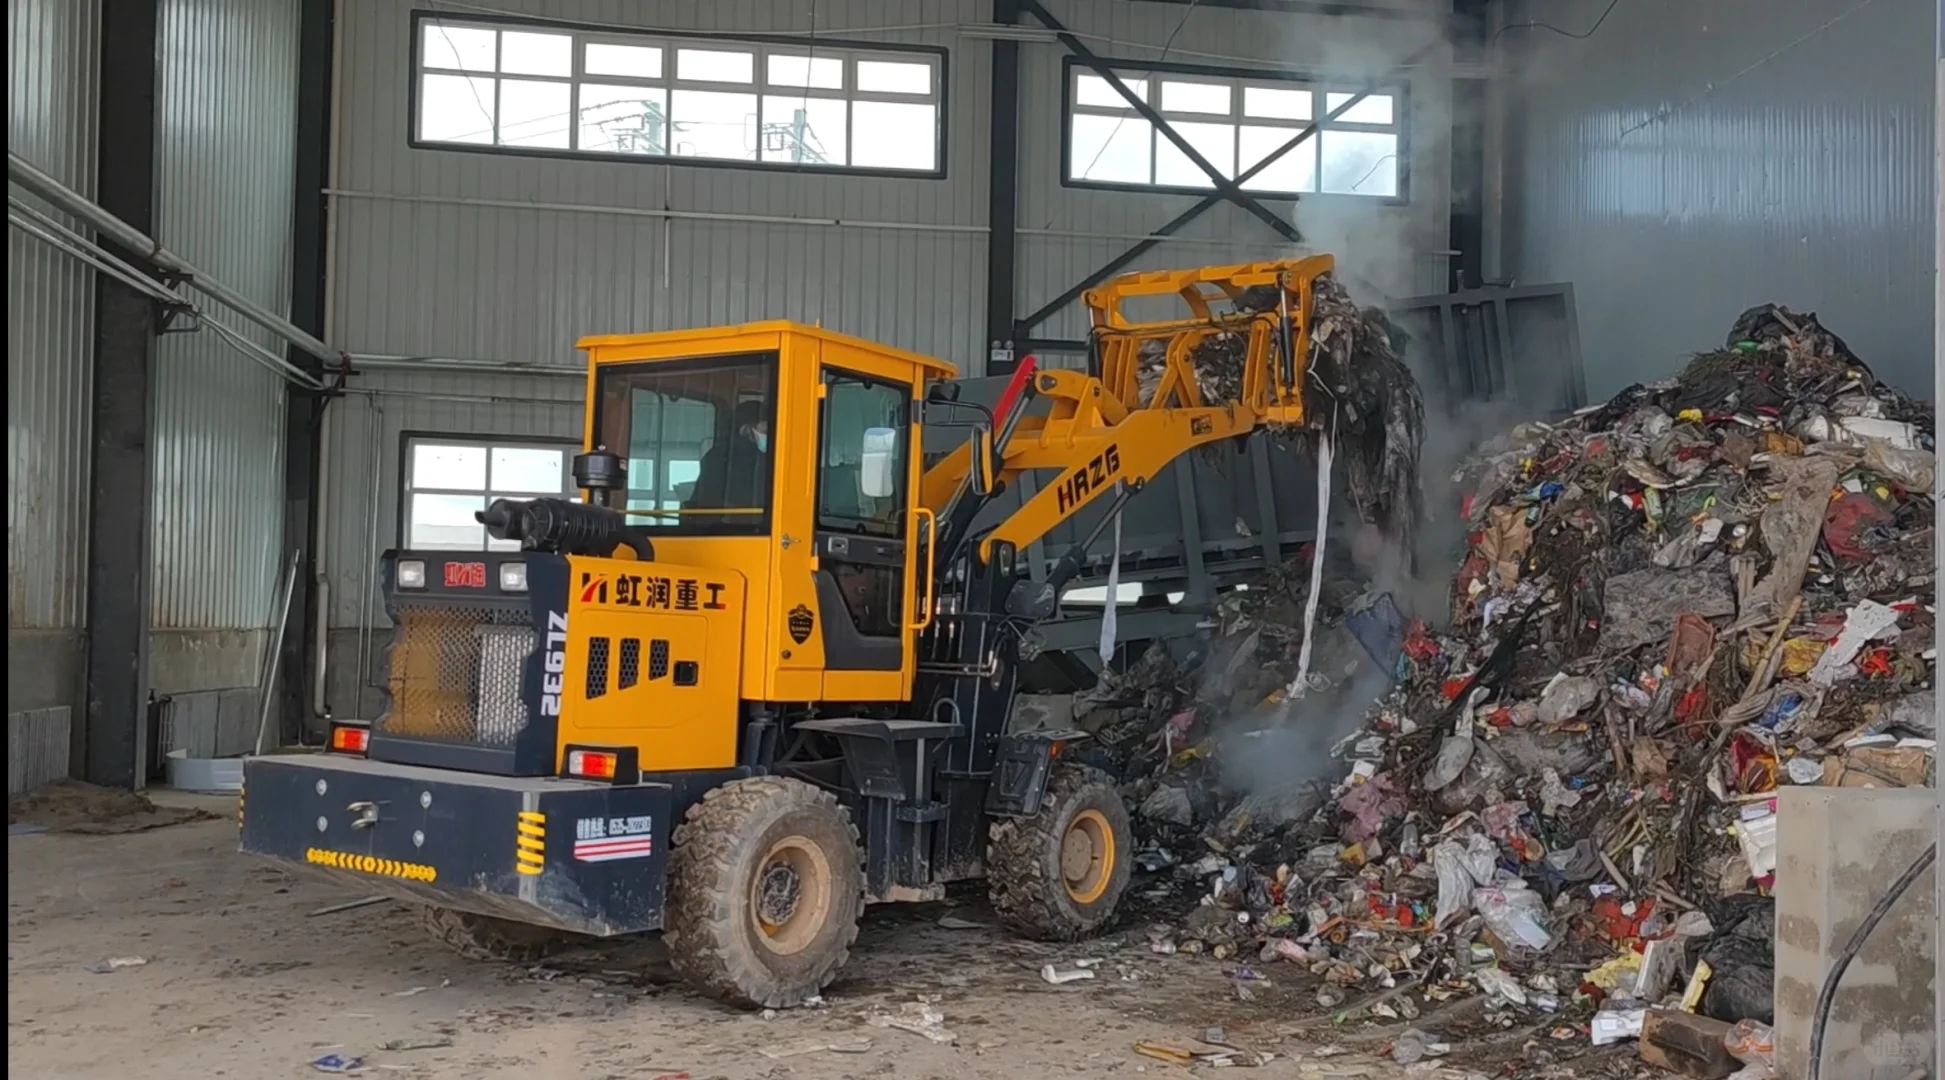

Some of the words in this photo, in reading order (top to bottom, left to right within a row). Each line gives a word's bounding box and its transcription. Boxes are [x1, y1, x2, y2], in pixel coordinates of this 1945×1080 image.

[1057, 442, 1120, 515] HRZG
[615, 573, 726, 611] 虹润重工
[540, 609, 568, 717] ZL932
